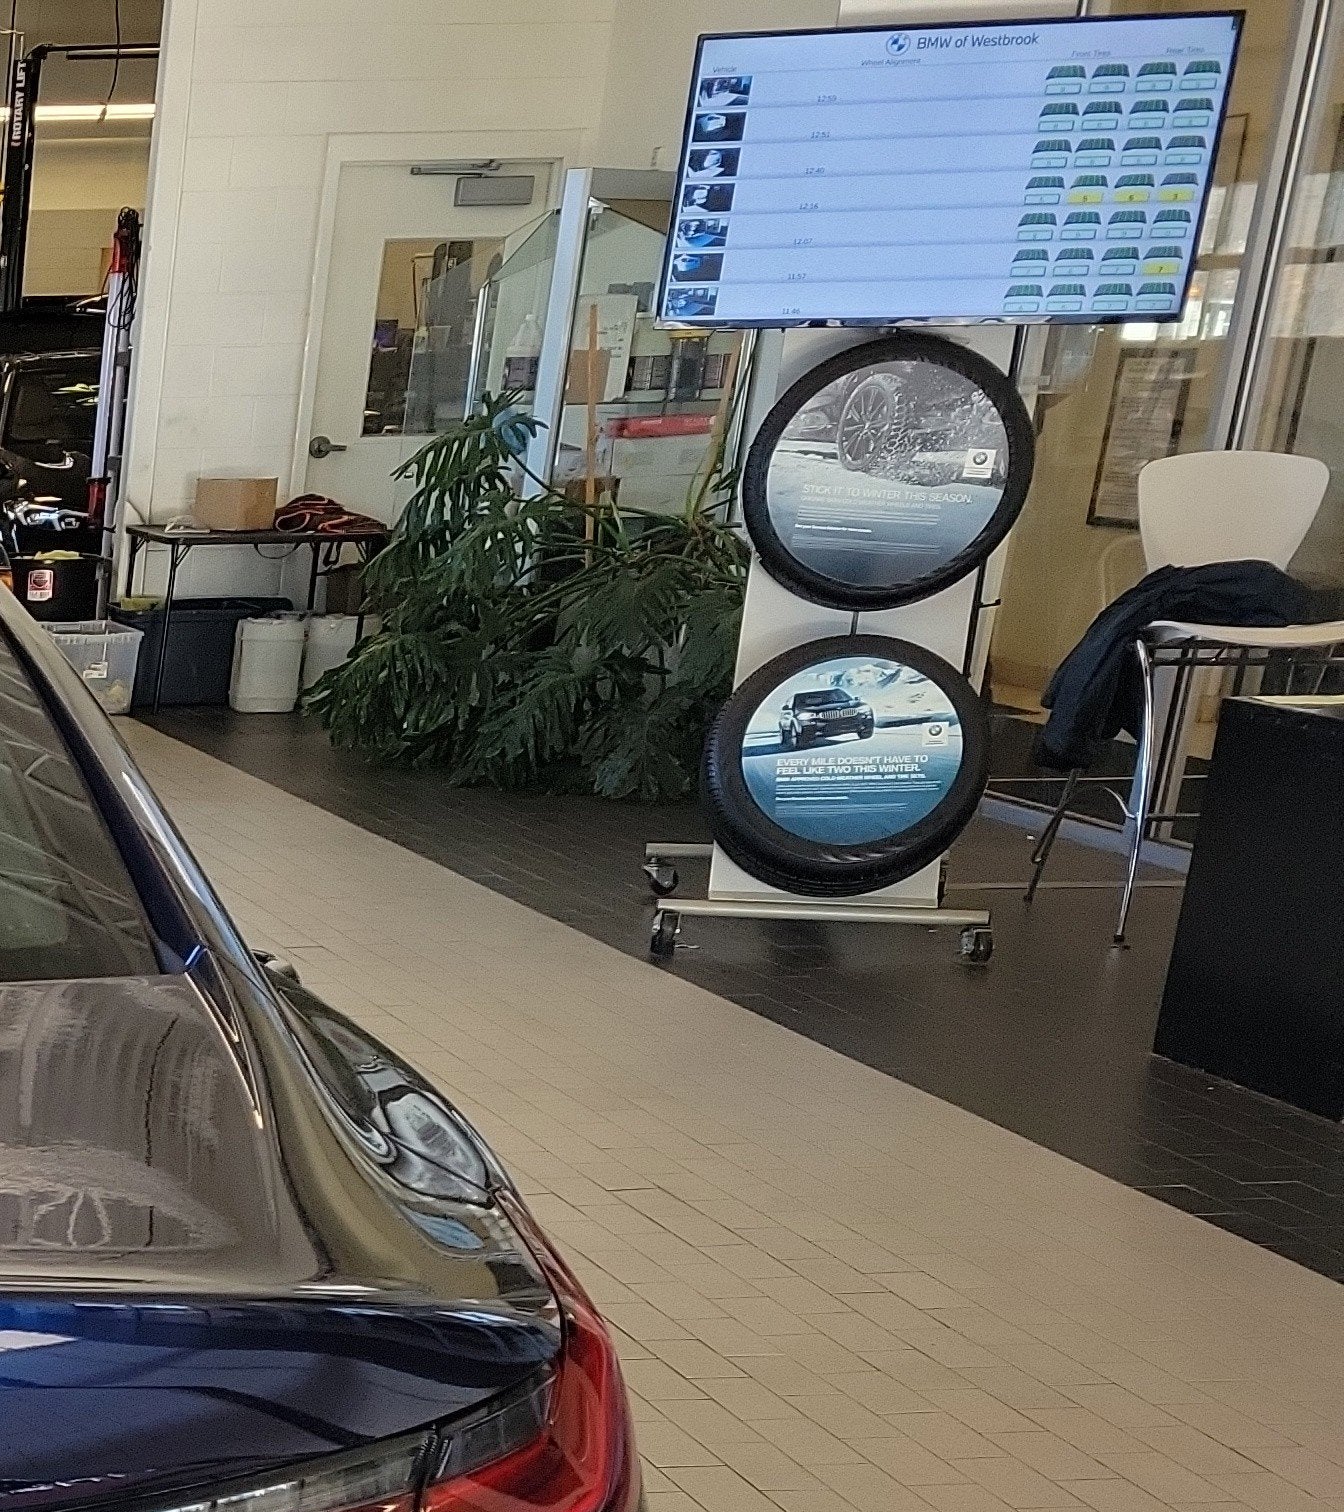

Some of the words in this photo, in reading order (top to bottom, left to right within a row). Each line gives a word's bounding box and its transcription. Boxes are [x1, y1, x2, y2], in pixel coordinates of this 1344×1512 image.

[916, 36, 952, 50] BMW
[955, 35, 969, 48] of
[971, 32, 1040, 47] Westbrook
[15, 60, 27, 88] LIFT
[712, 64, 738, 73] Vehicle
[12, 90, 25, 140] ROTARY
[802, 484, 832, 495] STICK
[833, 486, 843, 495] IT
[848, 487, 860, 497] TO
[863, 488, 900, 500] WINTER
[905, 491, 926, 502] THIS
[929, 492, 973, 504] SEASON.
[776, 766, 802, 775] FEEL
[802, 766, 826, 775] LIKE
[827, 765, 851, 774] TWO
[852, 764, 878, 773] THIS
[878, 763, 921, 773] WINTER.
[777, 758, 809, 767] EVERY
[811, 757, 836, 766] MILE
[838, 755, 882, 765] DOESN'T
[883, 755, 912, 764] HAVE
[913, 754, 928, 763] TO
